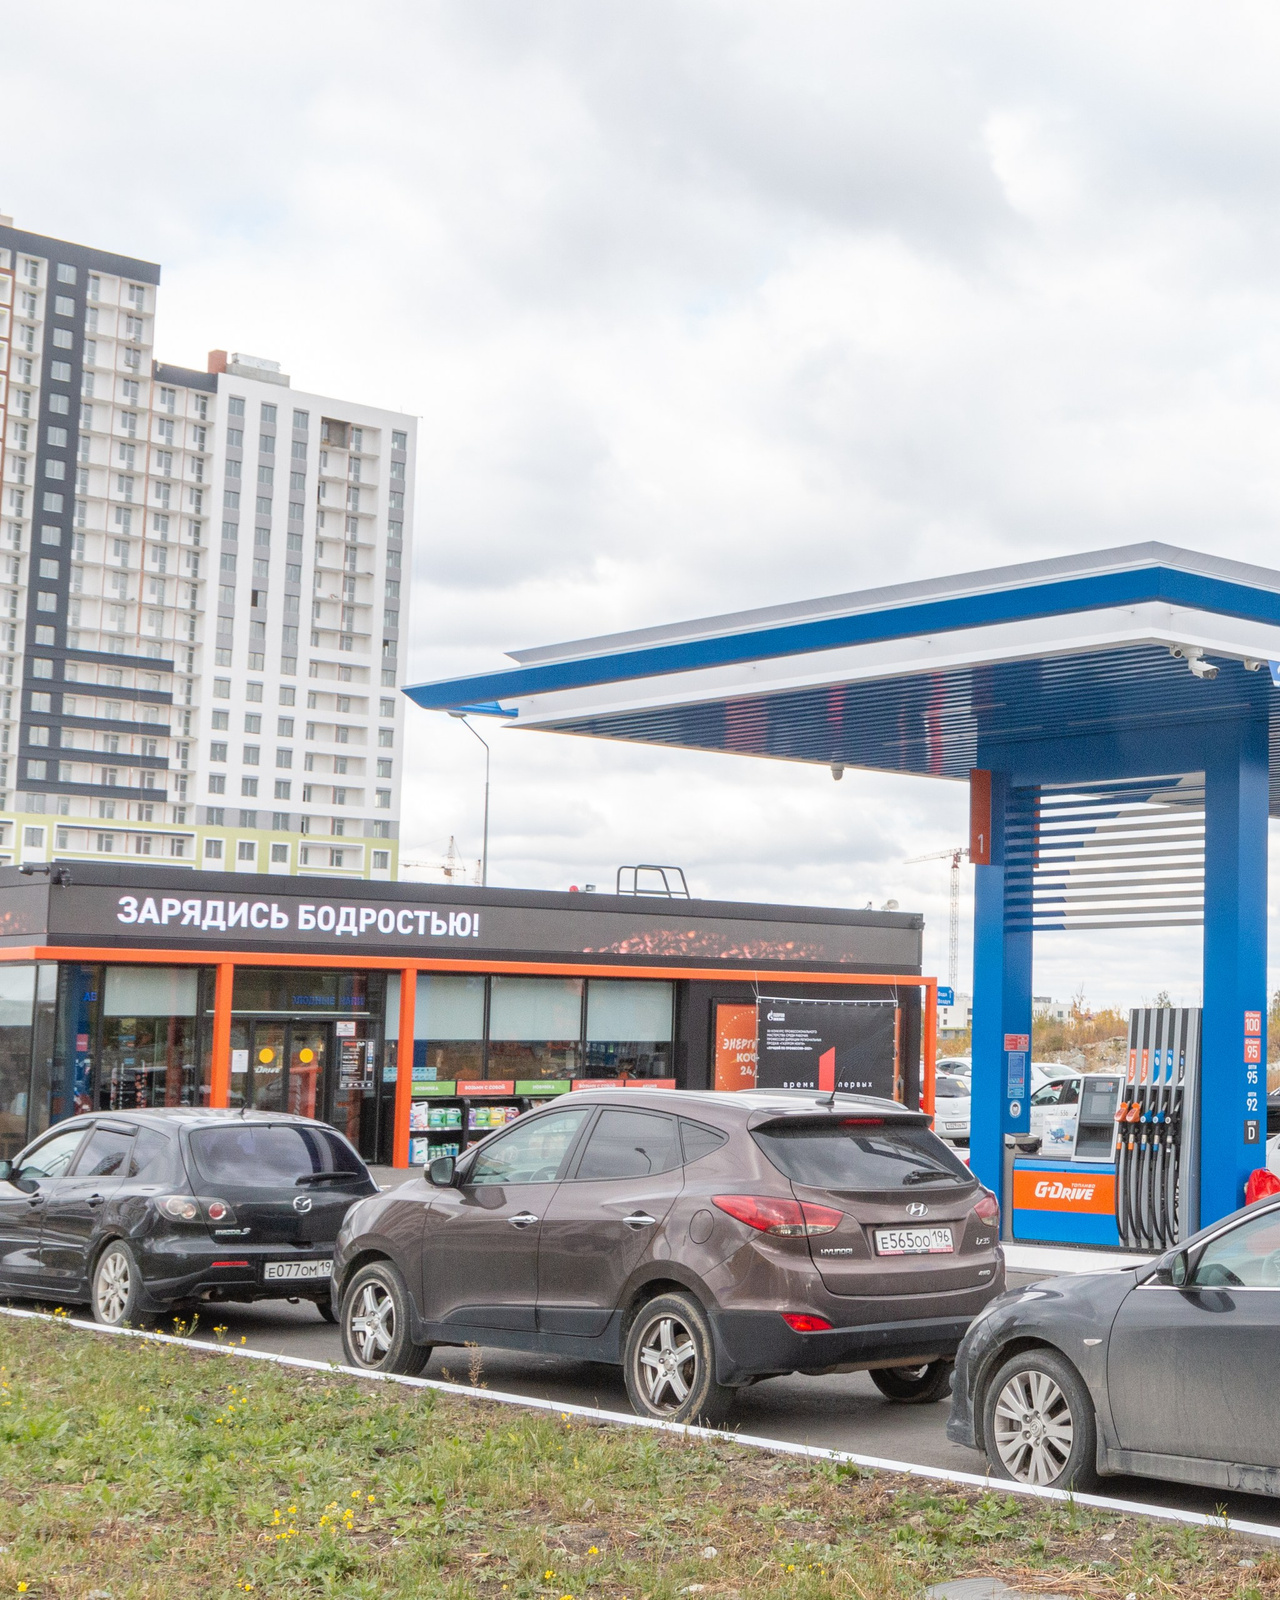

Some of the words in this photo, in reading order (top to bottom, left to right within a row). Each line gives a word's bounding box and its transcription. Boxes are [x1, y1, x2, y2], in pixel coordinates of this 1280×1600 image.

[977, 833, 984, 854] 1
[116, 896, 290, 931] ЗАРЯДИСЬ
[298, 904, 480, 937] БОДРОСТЬЮ!
[1245, 1019, 1259, 1031] 100
[736, 1052, 757, 1063] КОФ
[1247, 1046, 1258, 1058] 95
[1246, 1071, 1258, 1084] 95
[783, 1081, 815, 1089] время
[837, 1081, 873, 1090] первых
[1246, 1098, 1258, 1111] 92
[1248, 1127, 1256, 1140] D
[820, 1248, 853, 1256] HYUNDAI
